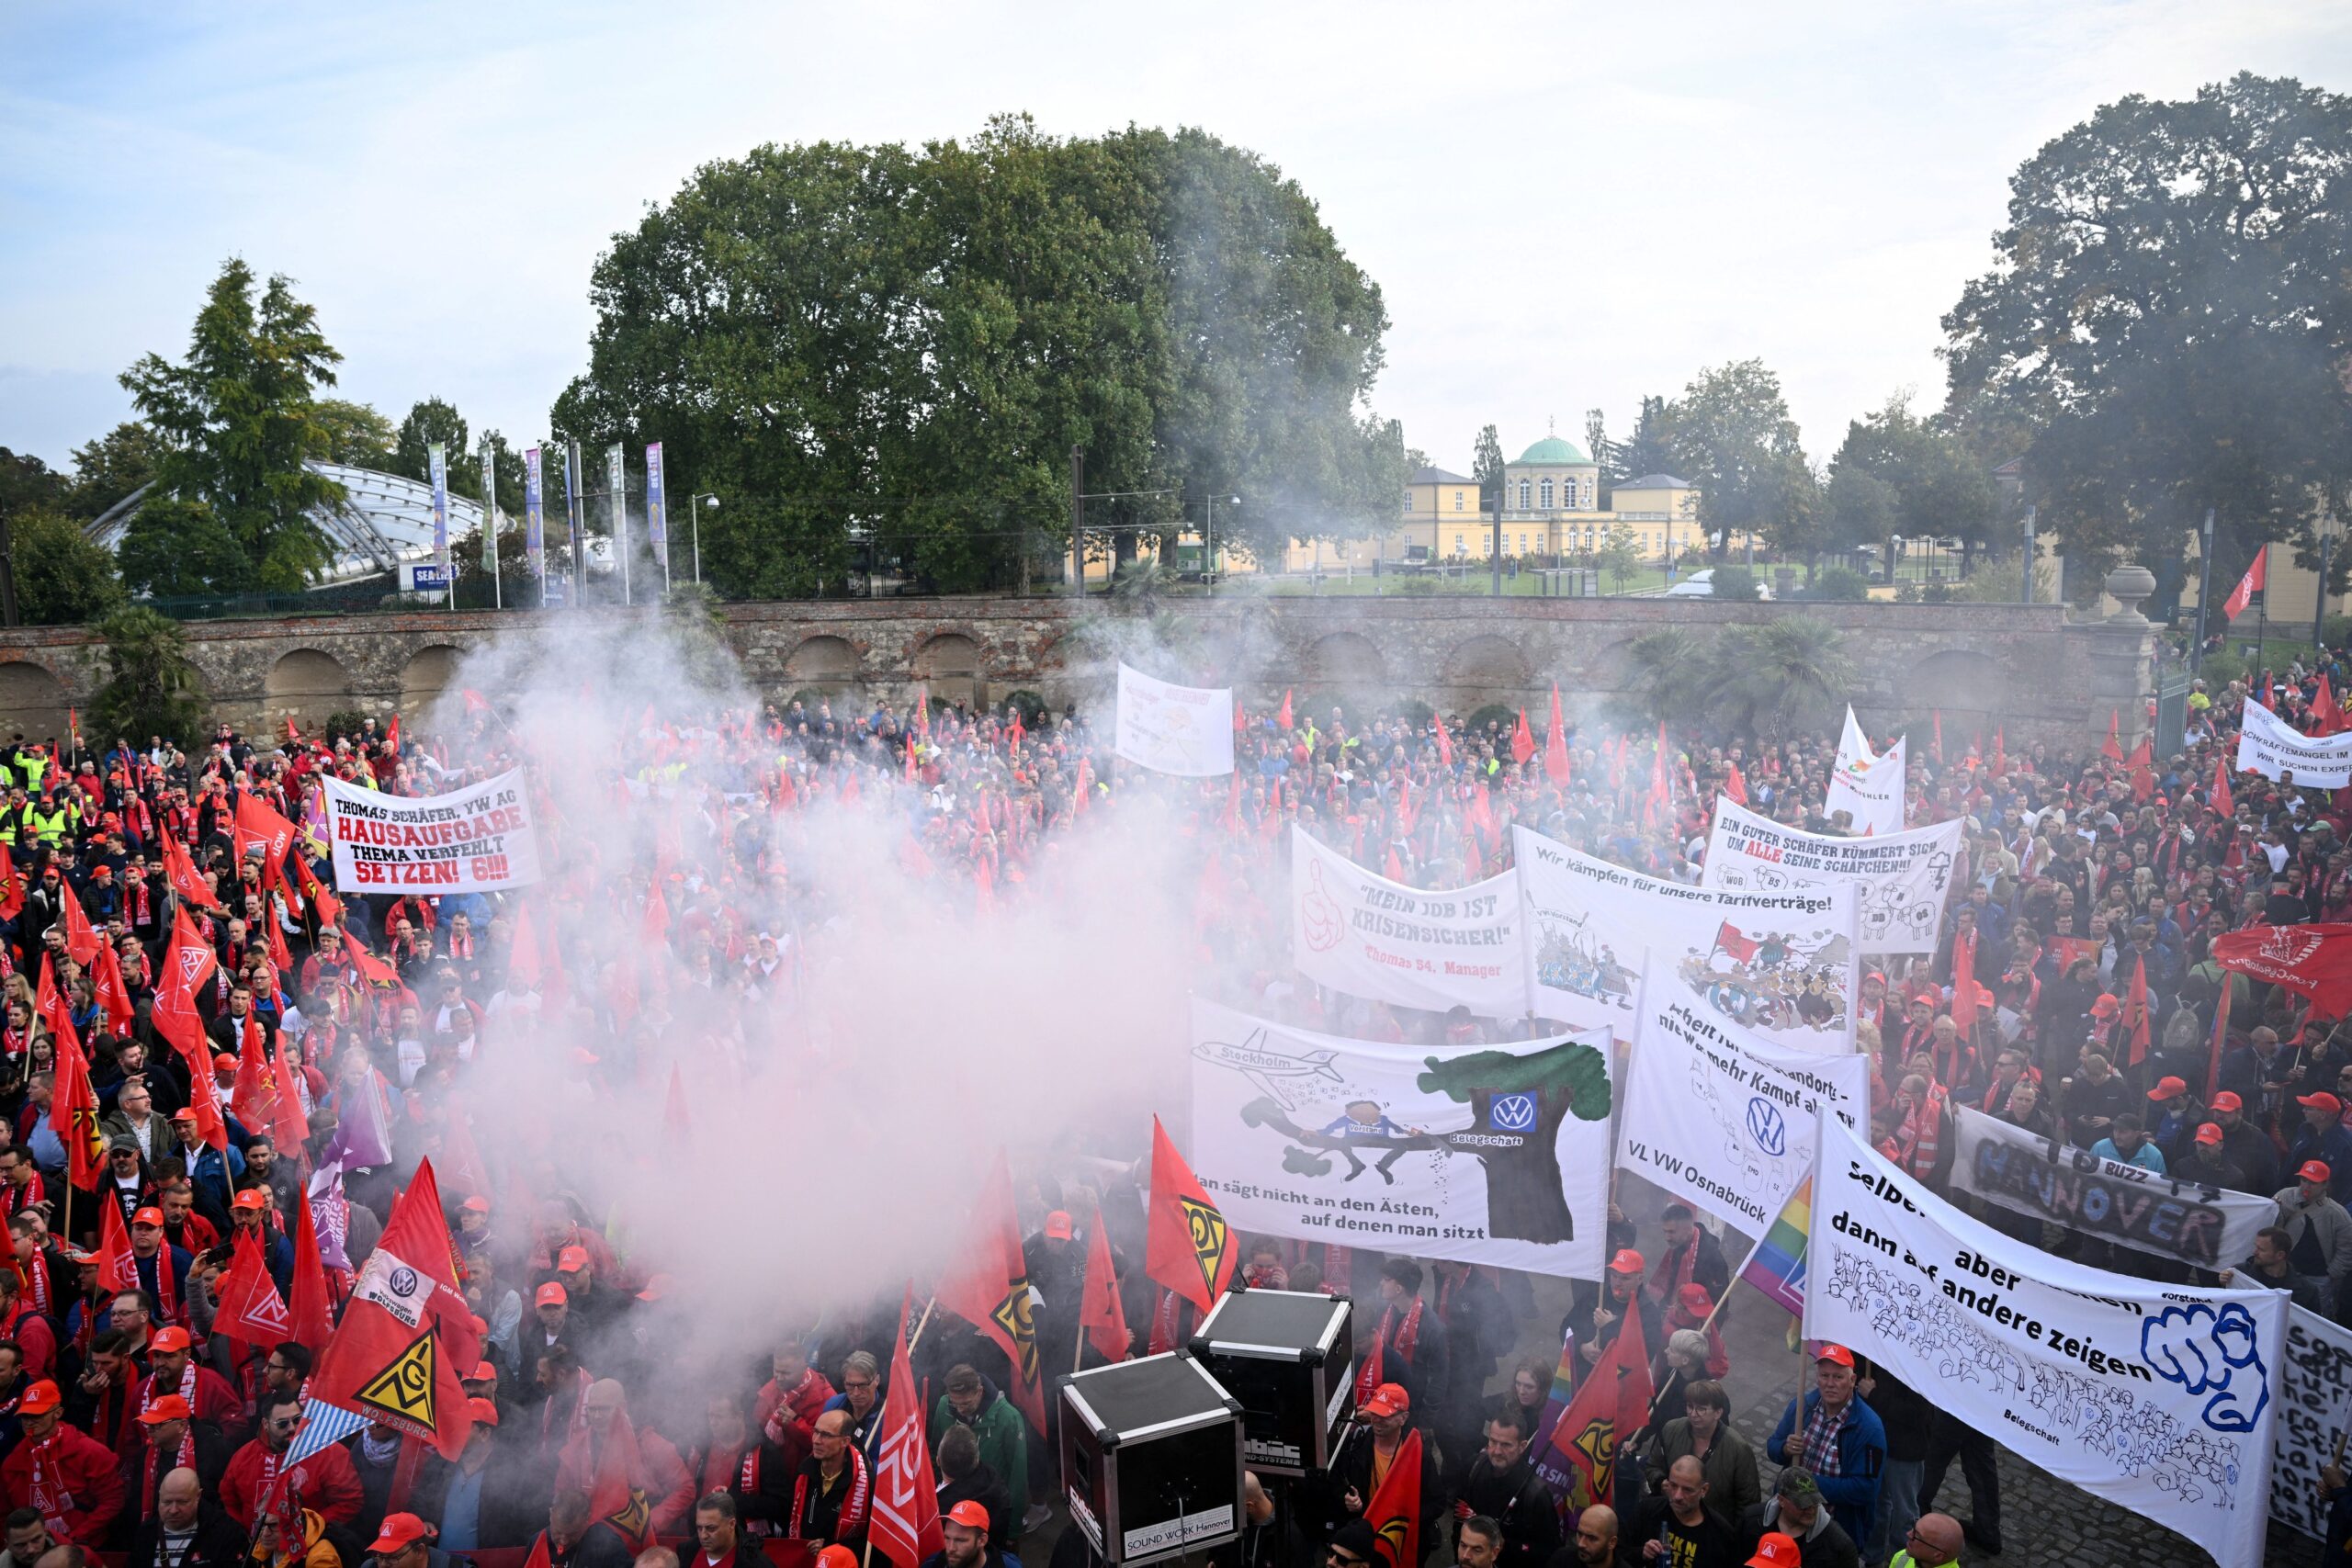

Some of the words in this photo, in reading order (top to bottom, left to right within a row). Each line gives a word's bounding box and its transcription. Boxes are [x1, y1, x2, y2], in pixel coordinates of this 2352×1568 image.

[417, 570, 434, 581] SEA
[2256, 751, 2275, 764] WIR
[2278, 759, 2318, 773] SUCHEN
[2336, 750, 2348, 759] IM
[335, 799, 388, 819] THOMAS
[391, 807, 461, 824] SCHÄFER,
[497, 789, 516, 806] AG
[337, 807, 526, 847] HAUSAUFGABE
[1720, 817, 1740, 833] EIN
[1742, 825, 1780, 847] GUTER
[1782, 837, 1838, 858] SCHÄFER
[1841, 845, 1905, 860] KÜMMERT
[1908, 841, 1938, 856] SICH
[350, 844, 411, 862] THEMA
[413, 836, 504, 859] VERFEHLT
[1727, 836, 1746, 852] UM
[1745, 840, 1783, 863] ALLE
[1783, 852, 1821, 870] SEINE
[355, 860, 460, 884] SETZEN!
[470, 854, 510, 882] 6!!!
[1535, 846, 1564, 865] Wir
[1566, 855, 1629, 886] kämpfen
[1633, 875, 1657, 893] für
[1659, 884, 1713, 903] unsere
[1716, 892, 1832, 914] Tarifverträge!
[1725, 875, 1744, 886] WOB
[1768, 876, 1781, 887] BS
[1421, 902, 1456, 919] JOB
[1464, 895, 1498, 919] IST
[1364, 945, 1413, 969] Thomas
[1444, 961, 1501, 979] Manager
[1221, 1047, 1291, 1068] Stockholm
[1707, 1050, 1748, 1082] mehr
[1749, 1071, 1801, 1108] Kampf
[1349, 1123, 1384, 1134] Vorstand
[1493, 1096, 1533, 1129] VW
[1451, 1133, 1523, 1146] Belegschaft
[1629, 1139, 1648, 1162] VL
[1654, 1149, 1684, 1176] VW
[1684, 1166, 1767, 1224] Osnabrück
[2104, 1161, 2149, 1184] BUZZ
[1196, 1175, 1219, 1190] an
[1223, 1179, 1259, 1200] sägt
[1263, 1186, 1309, 1205] nicht
[1314, 1197, 1336, 1208] an
[1340, 1197, 1374, 1212] den
[1379, 1197, 1440, 1219] Ästen,
[1301, 1212, 1330, 1227] auf
[1335, 1214, 1394, 1233] denen
[1398, 1224, 1438, 1238] man
[1442, 1223, 1485, 1240] sitzt
[1954, 1249, 2021, 1292] aber
[379, 1288, 413, 1315] Volkswagen
[440, 1283, 454, 1295] IGM
[1832, 1211, 1897, 1258] dann
[1942, 1279, 2042, 1340] andere
[2047, 1328, 2153, 1382] zeigen
[368, 1291, 417, 1326] WOLFSBURG
[361, 1404, 428, 1438] WOLFSBURG
[2003, 1408, 2061, 1447] Belegschaft
[1127, 1534, 1163, 1551] SOUND
[1165, 1526, 1194, 1540] WORK
[1196, 1518, 1231, 1532] Hannover
